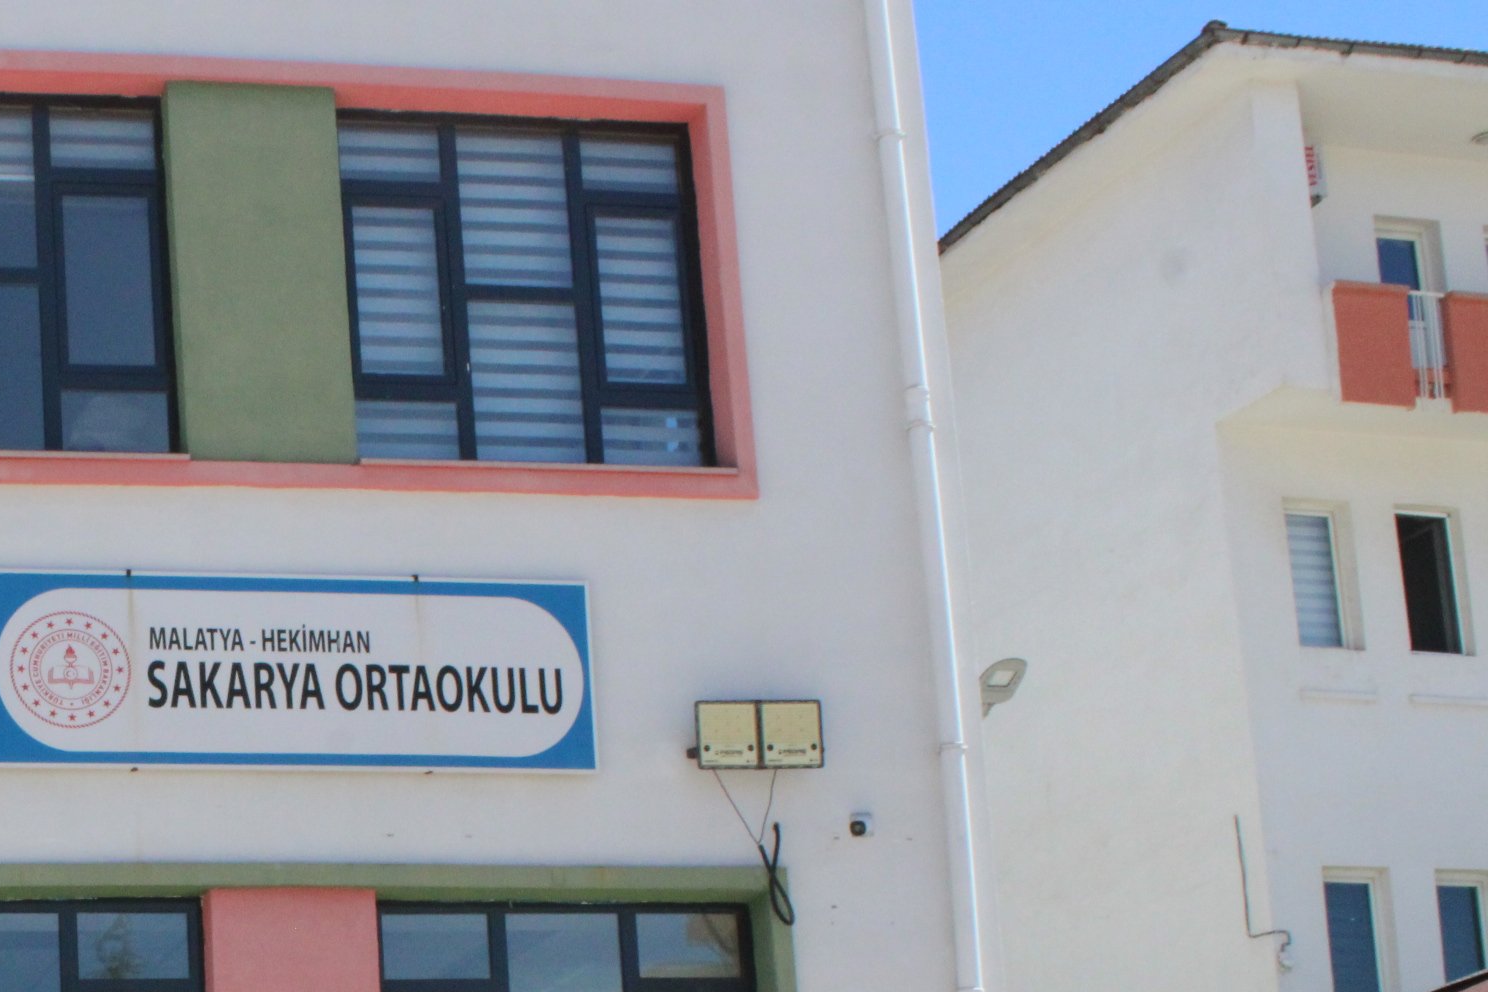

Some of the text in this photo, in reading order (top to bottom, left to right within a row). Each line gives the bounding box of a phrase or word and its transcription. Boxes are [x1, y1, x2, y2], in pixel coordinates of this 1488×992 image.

[149, 626, 245, 652] MALATYA
[261, 624, 371, 654] HEKİMHAN
[147, 660, 564, 715] SAKARYA ORTAOKULU
